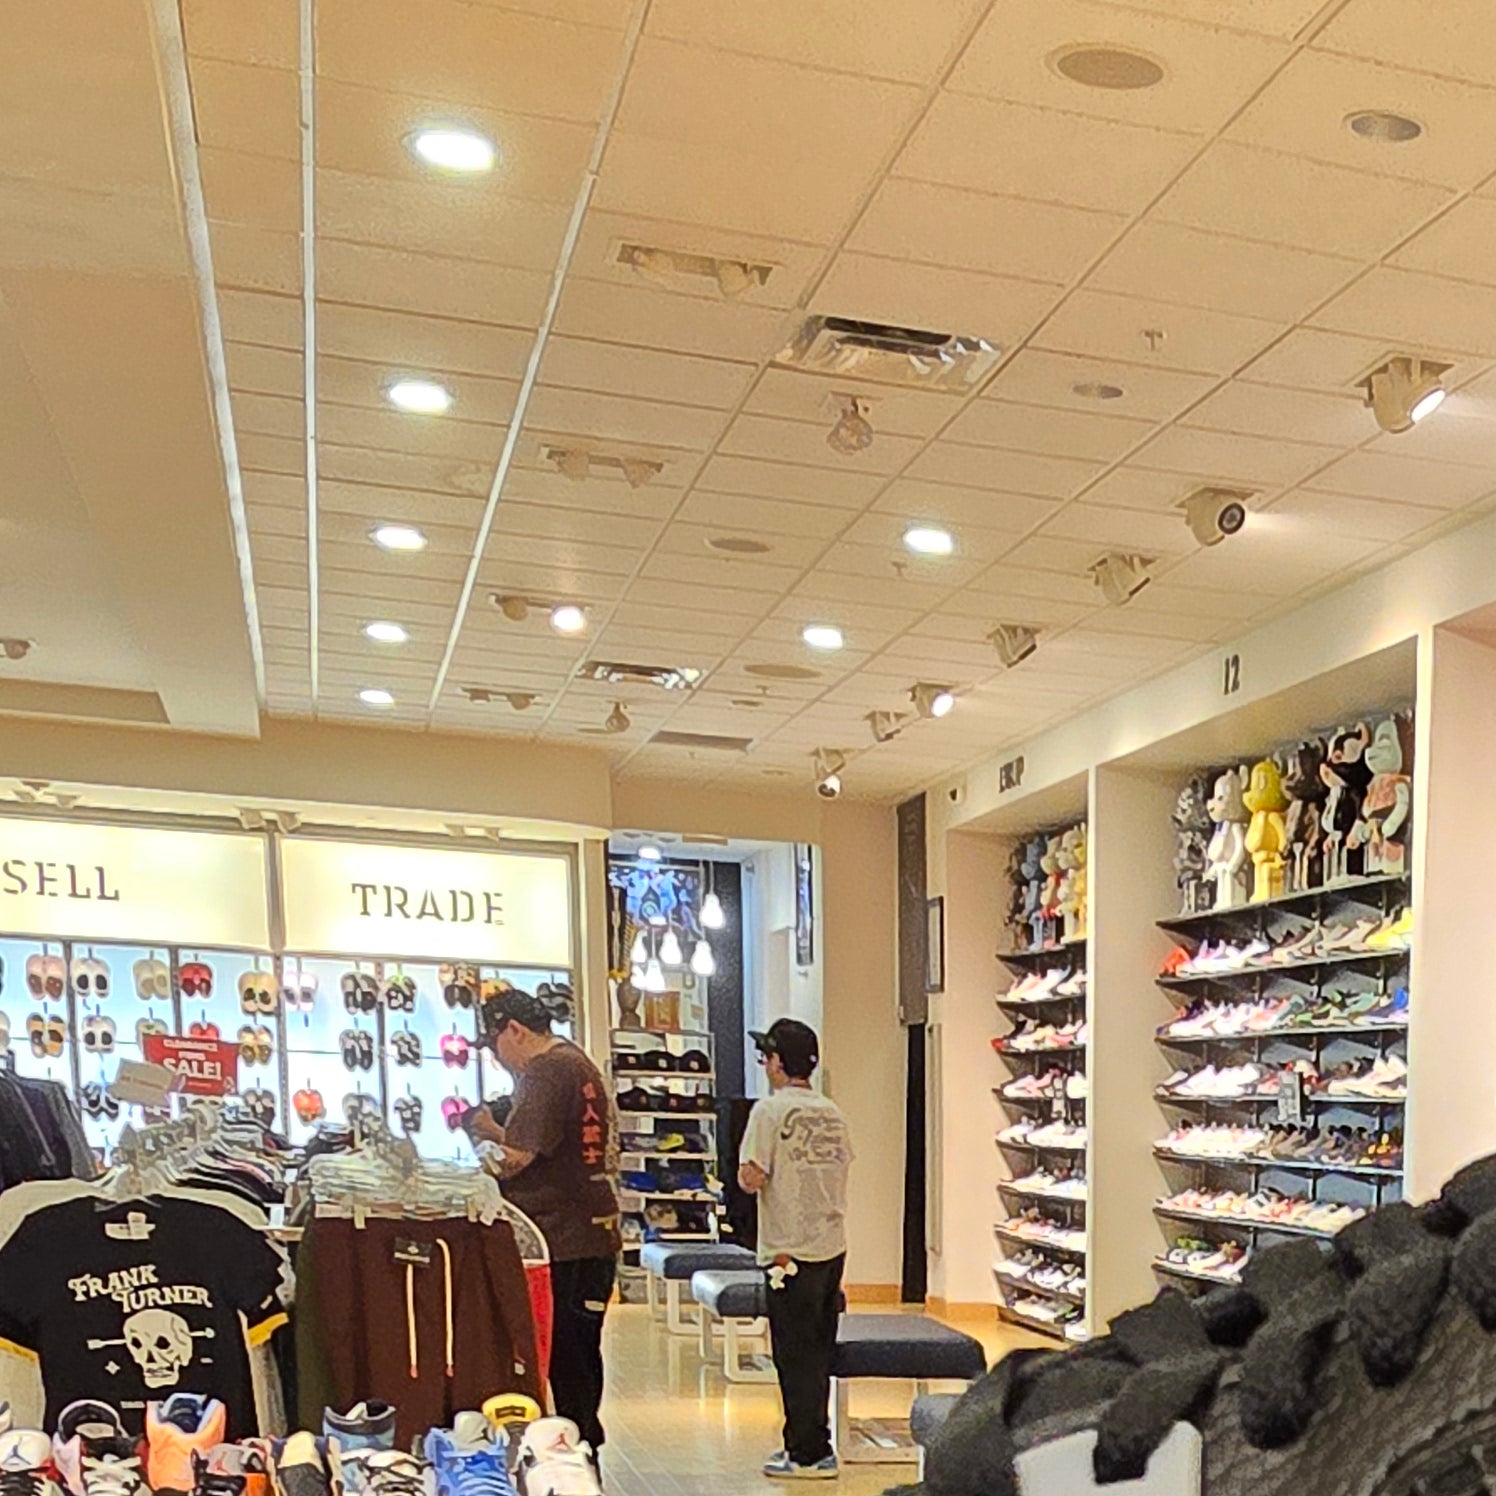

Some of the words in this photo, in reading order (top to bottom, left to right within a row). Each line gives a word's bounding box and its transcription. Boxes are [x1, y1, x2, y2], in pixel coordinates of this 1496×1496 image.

[1223, 654, 1241, 695] 12
[2, 859, 120, 901] SELL
[351, 883, 505, 925] TRADE
[68, 1264, 159, 1301] FRANK
[111, 1286, 213, 1313] TURNER
